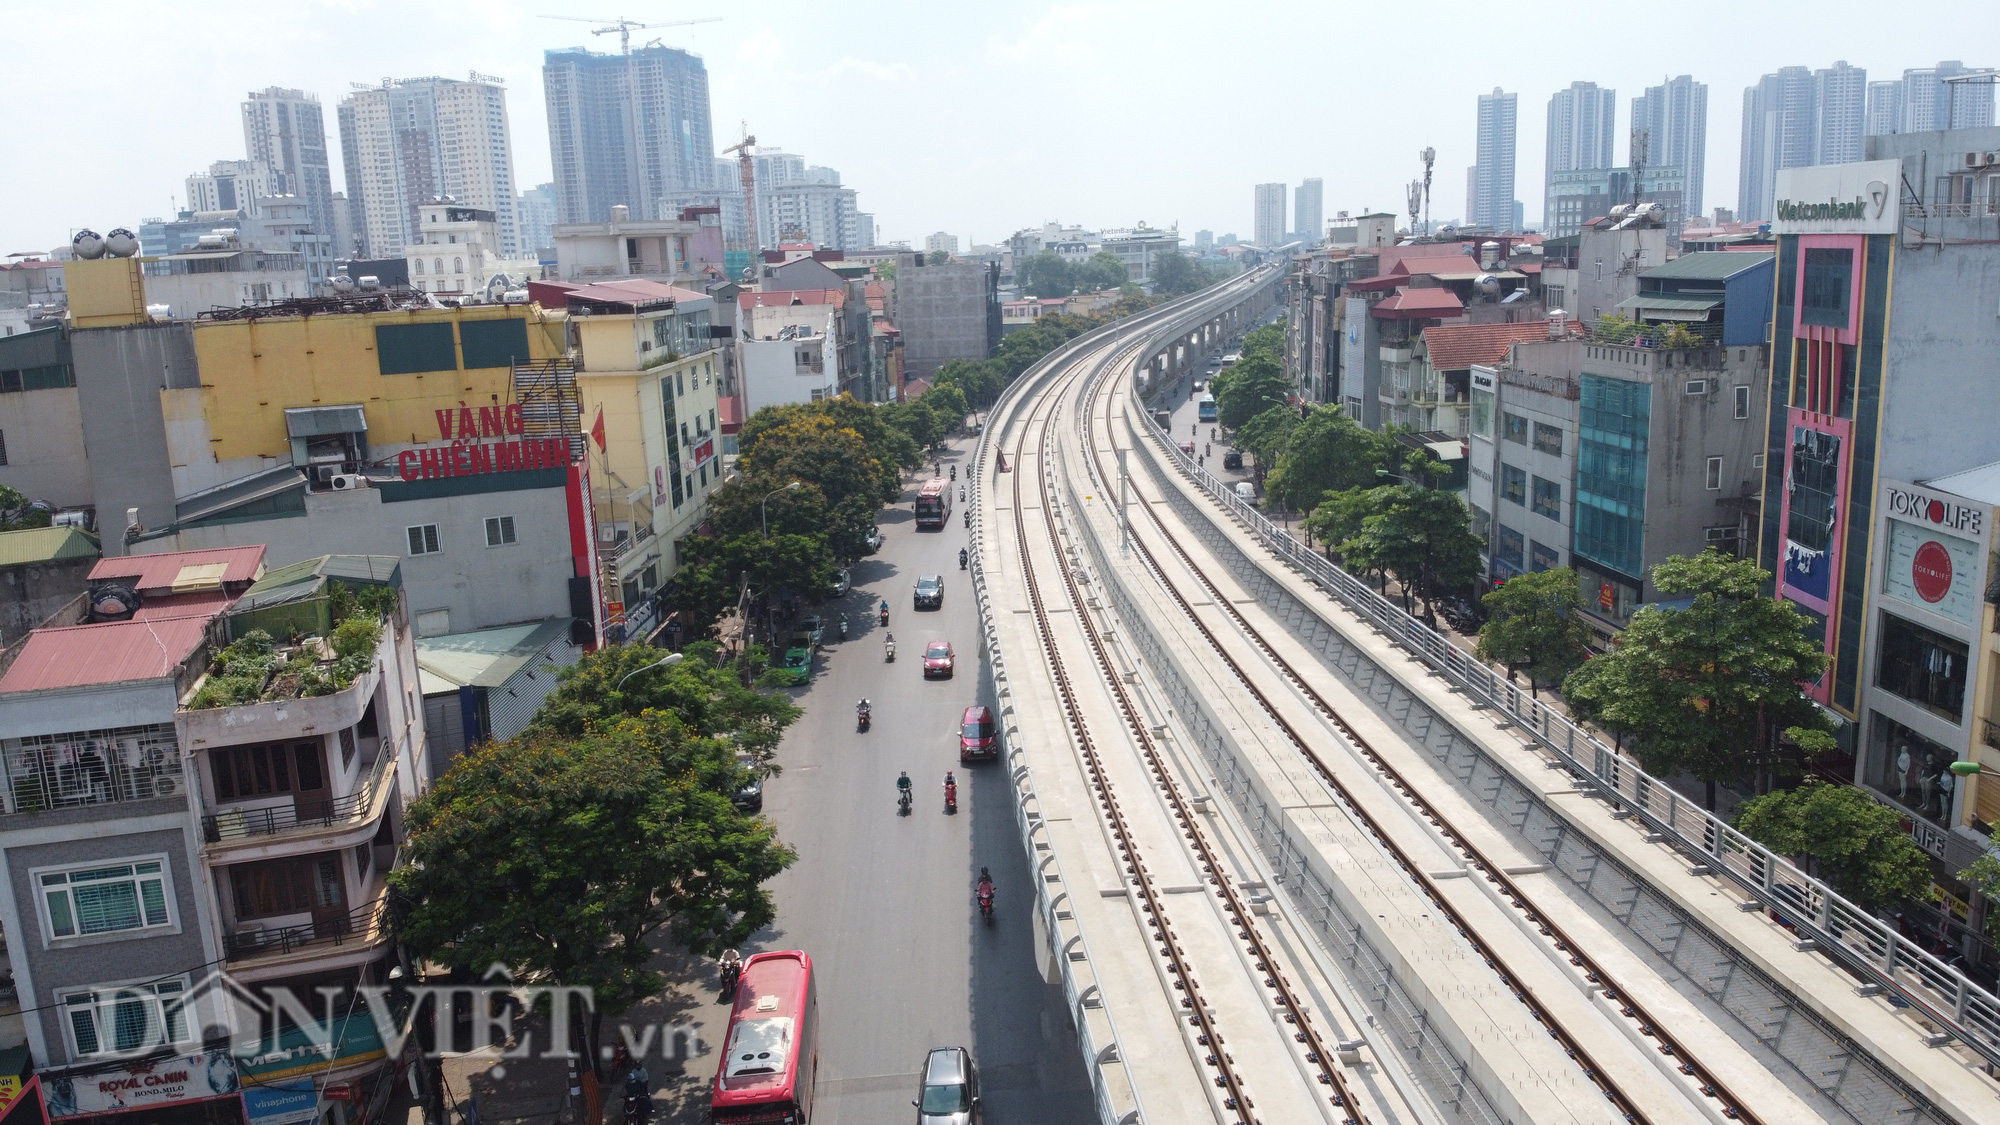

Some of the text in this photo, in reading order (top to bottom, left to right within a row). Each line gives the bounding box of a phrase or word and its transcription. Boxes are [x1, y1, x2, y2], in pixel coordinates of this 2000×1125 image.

[1777, 196, 1867, 222] Vietcombank
[435, 401, 525, 441] VÀNG
[400, 437, 572, 482] CHIẾN MINH
[1911, 820, 1946, 857] LIFE
[98, 1070, 188, 1093] ROYAL CANIN
[252, 1092, 308, 1109] vinaphone
